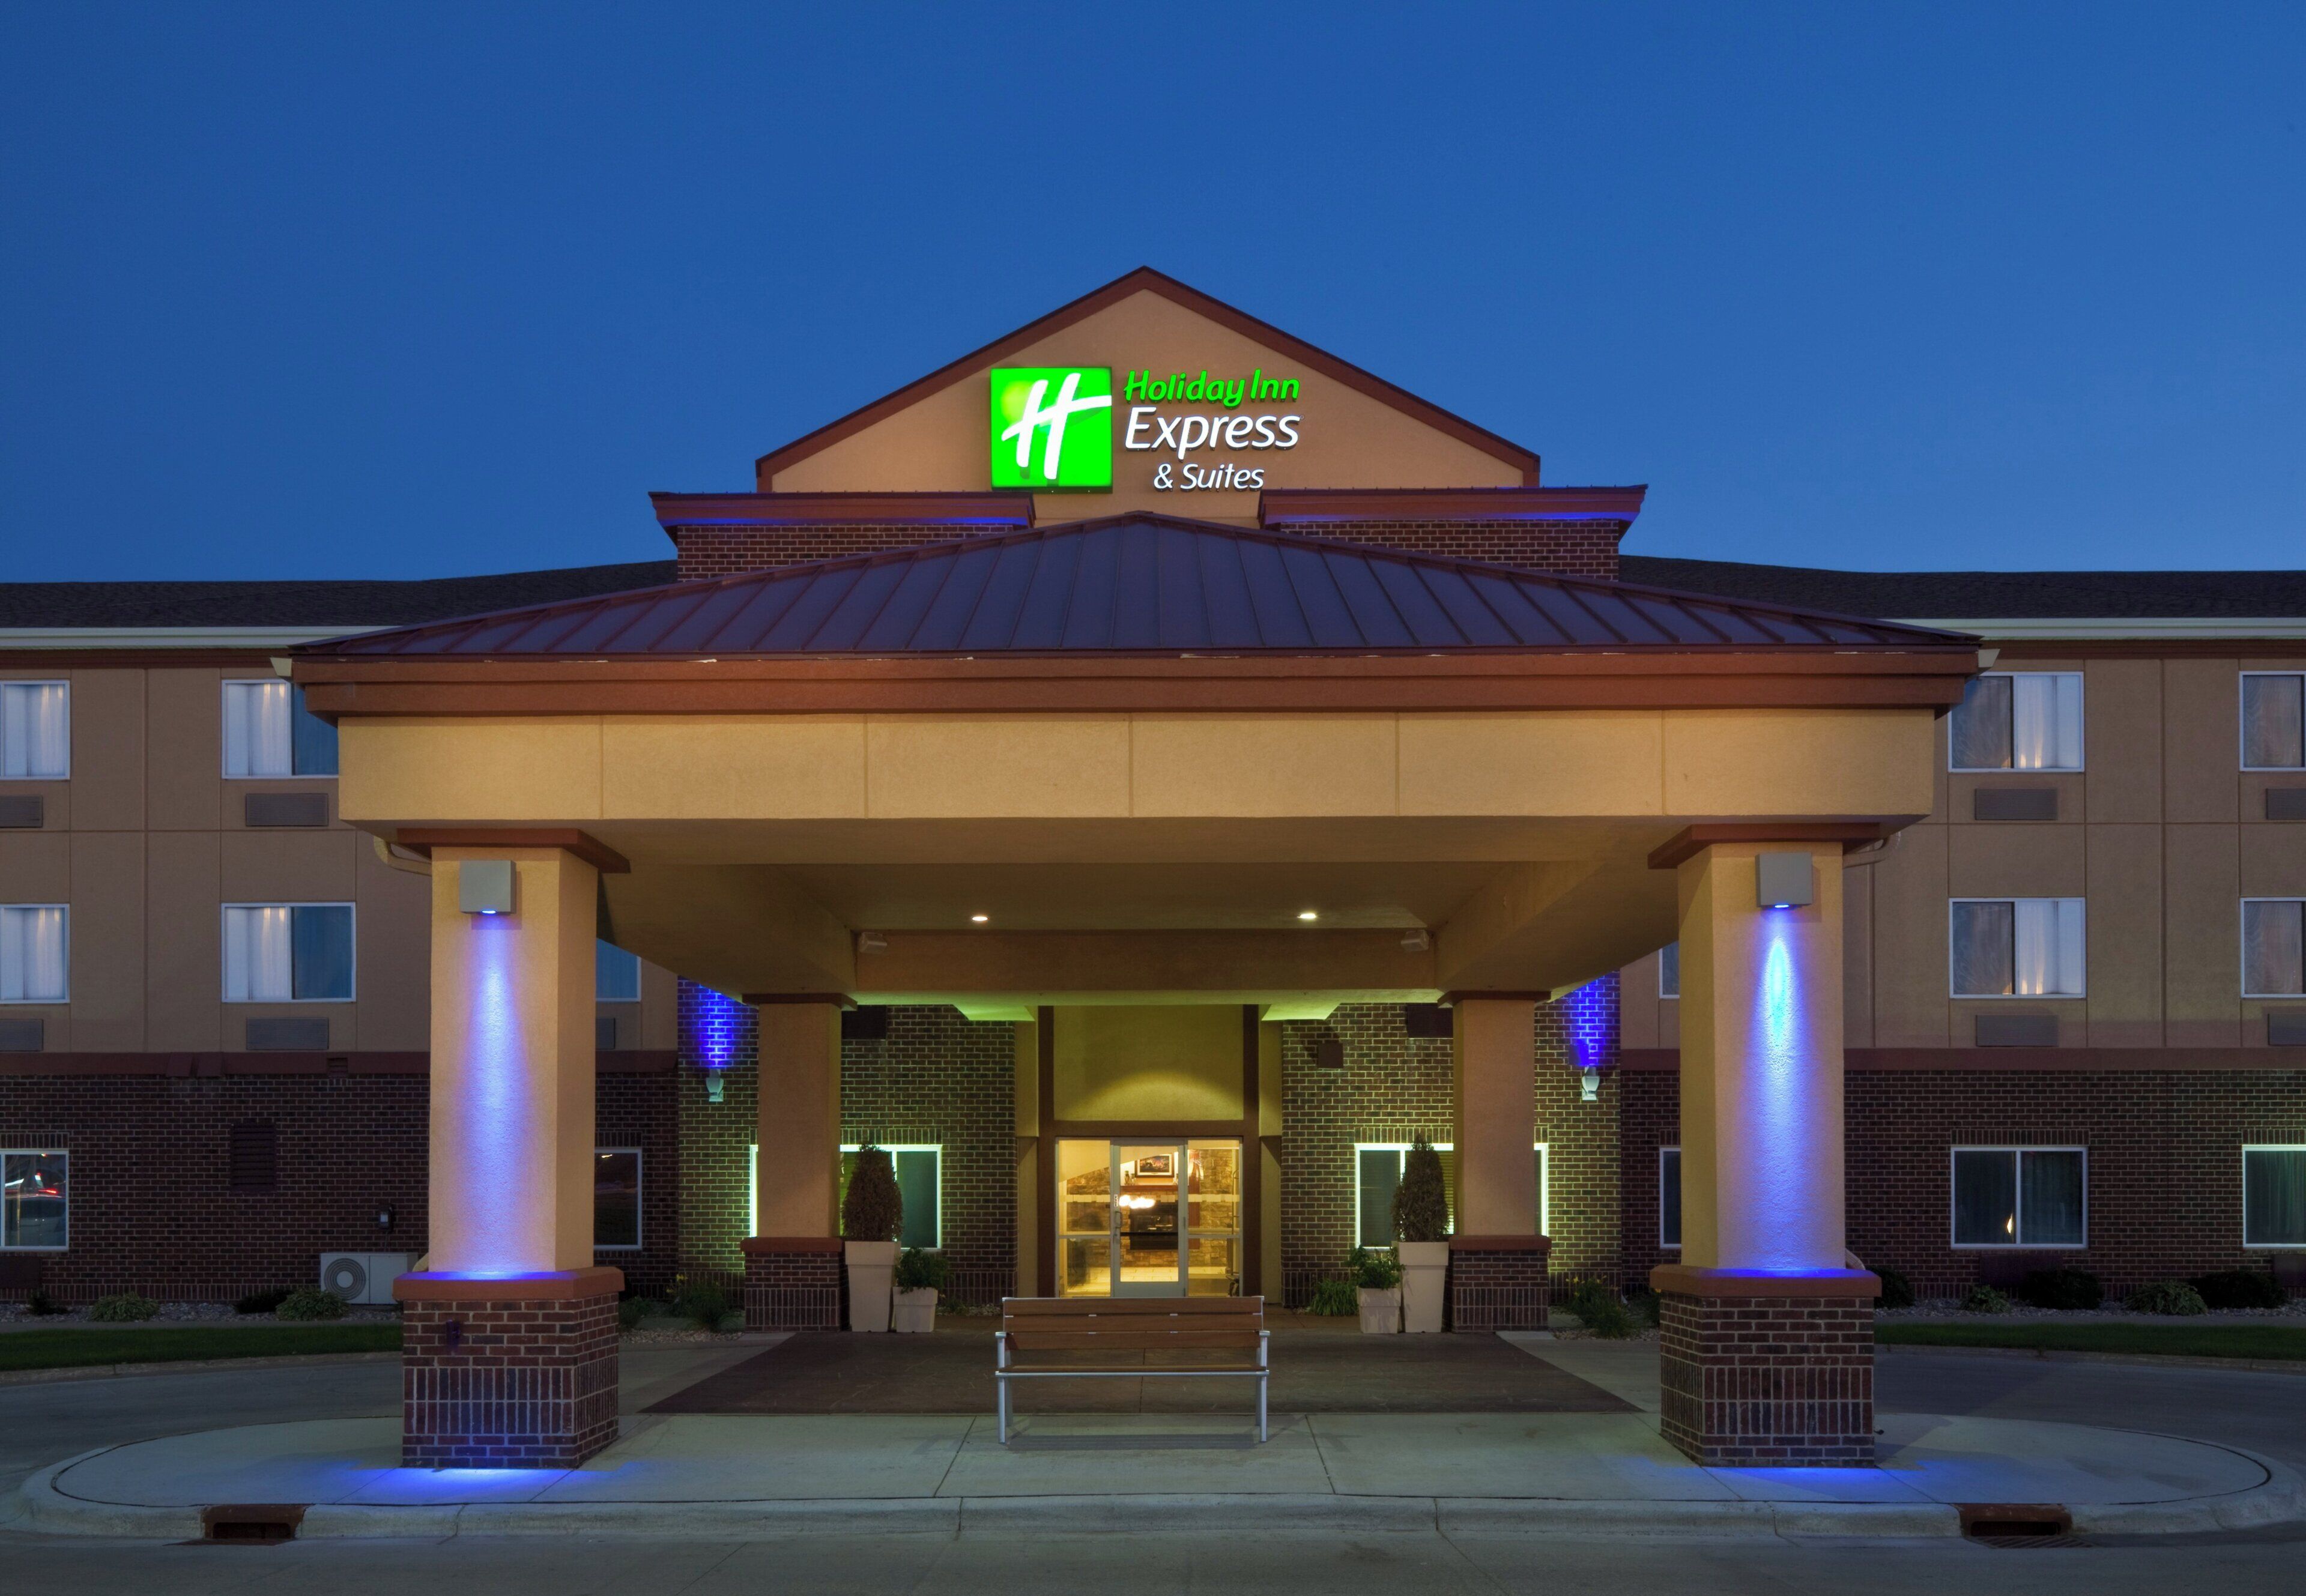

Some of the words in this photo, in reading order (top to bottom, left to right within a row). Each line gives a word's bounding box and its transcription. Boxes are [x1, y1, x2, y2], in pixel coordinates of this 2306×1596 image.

[1124, 369, 1245, 407] Holiday
[1250, 369, 1300, 399] Inn
[1002, 373, 1112, 479] H
[1125, 407, 1301, 460] Express
[1154, 464, 1173, 489] &
[1180, 463, 1265, 489] Suites
